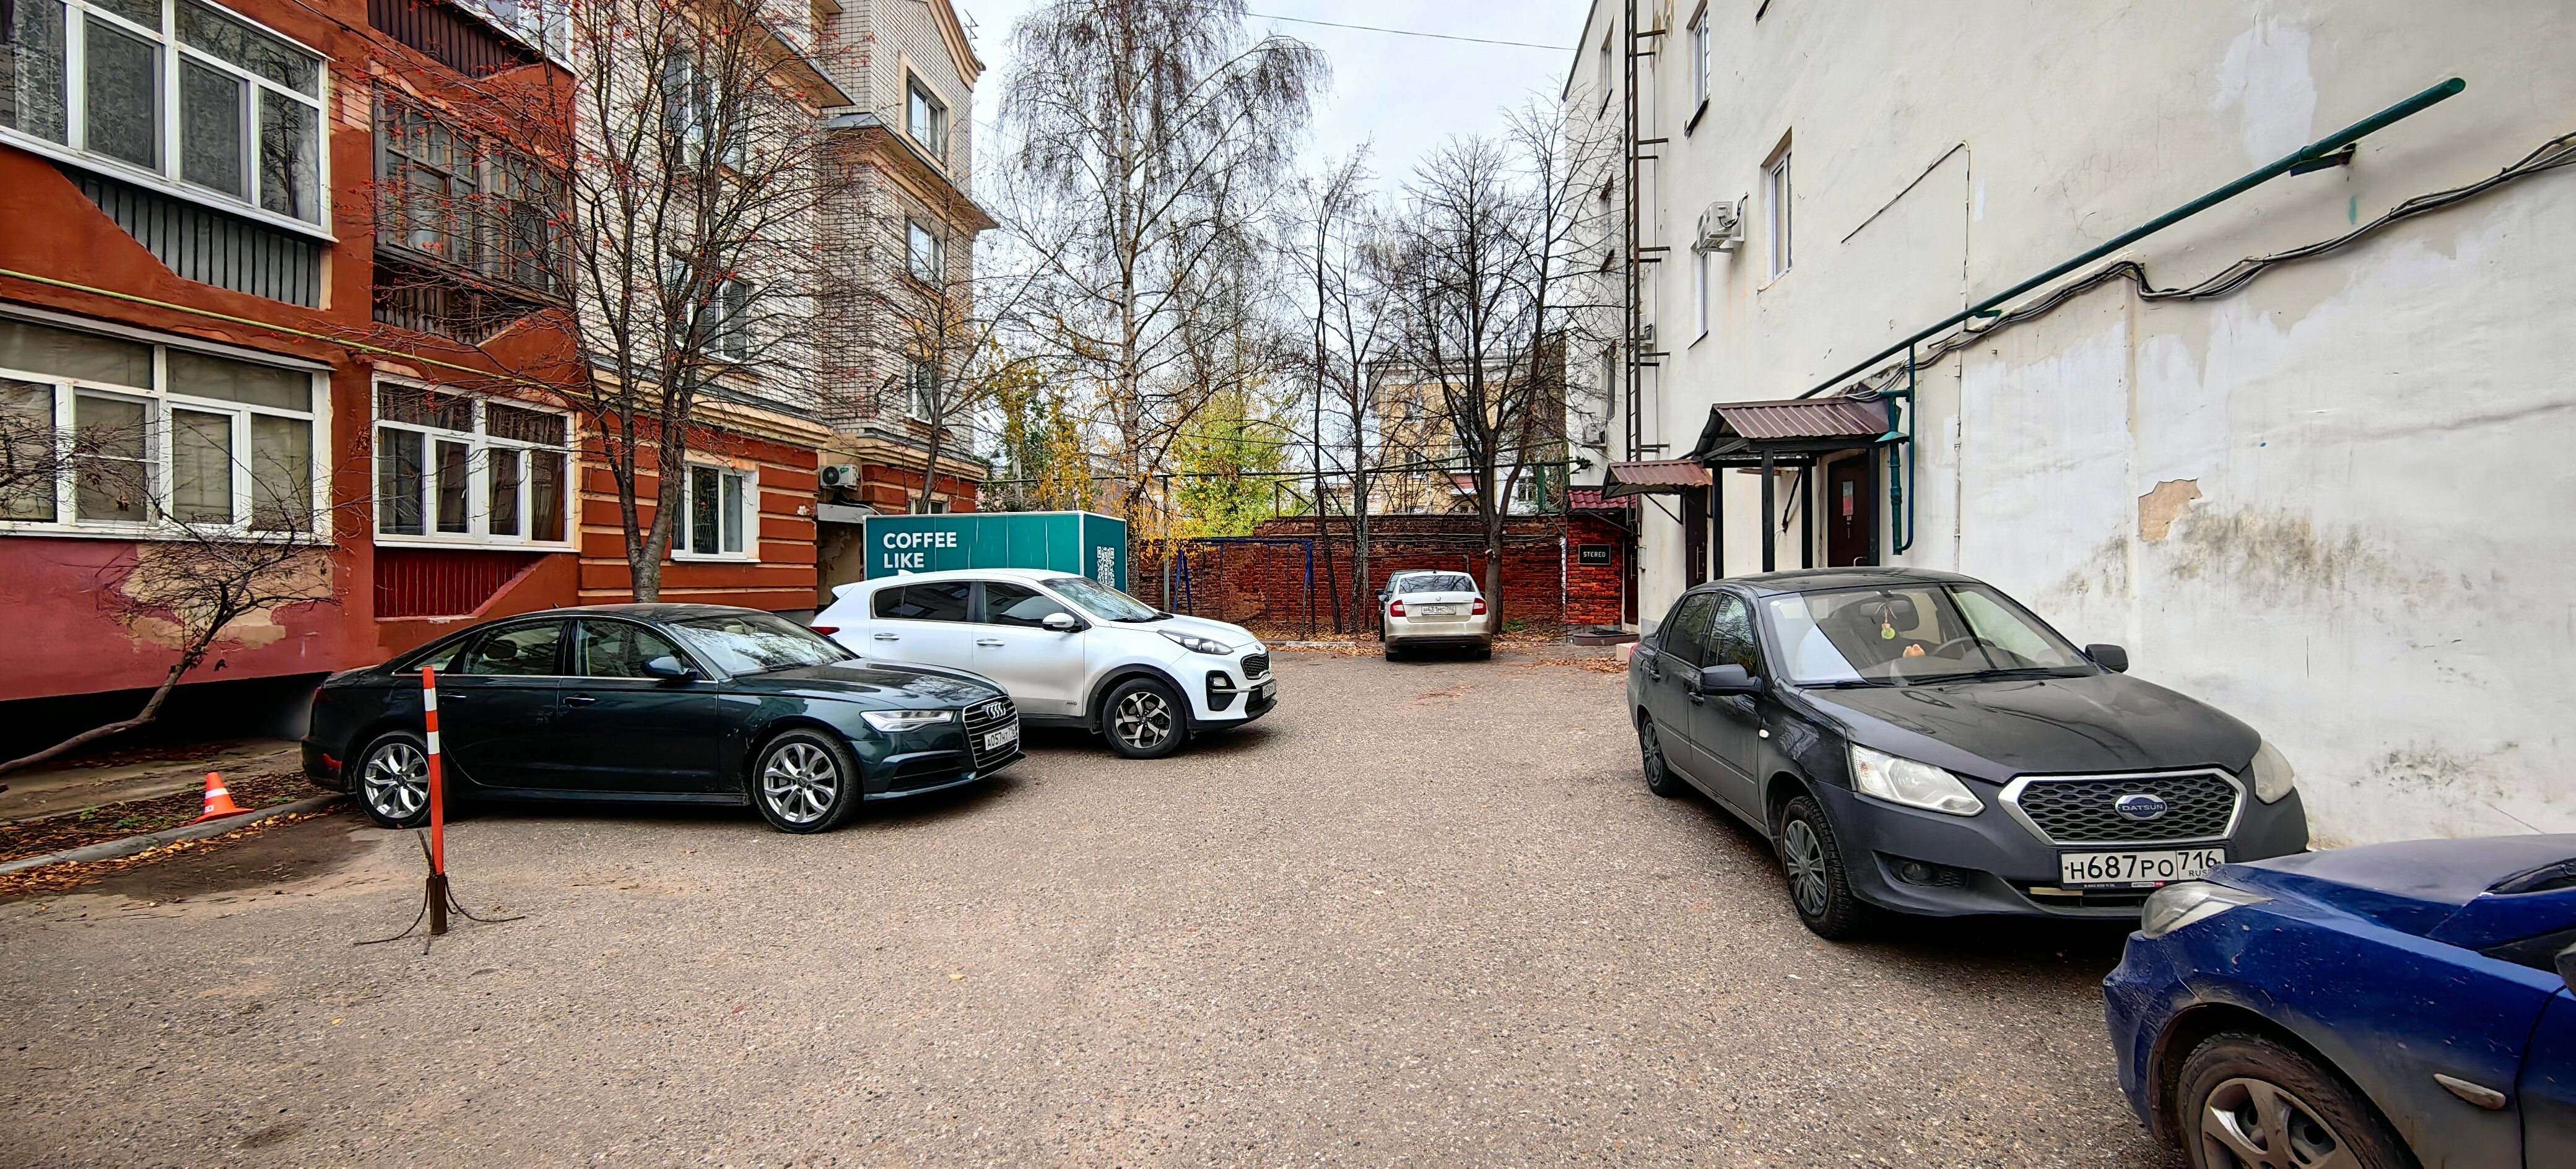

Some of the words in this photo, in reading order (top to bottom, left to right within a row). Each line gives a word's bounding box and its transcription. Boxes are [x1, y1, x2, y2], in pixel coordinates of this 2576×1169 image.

[883, 532, 957, 549] COFFEE
[884, 552, 925, 568] LIKE
[2122, 803, 2164, 811] DATSUN
[2178, 851, 2217, 870] 716
